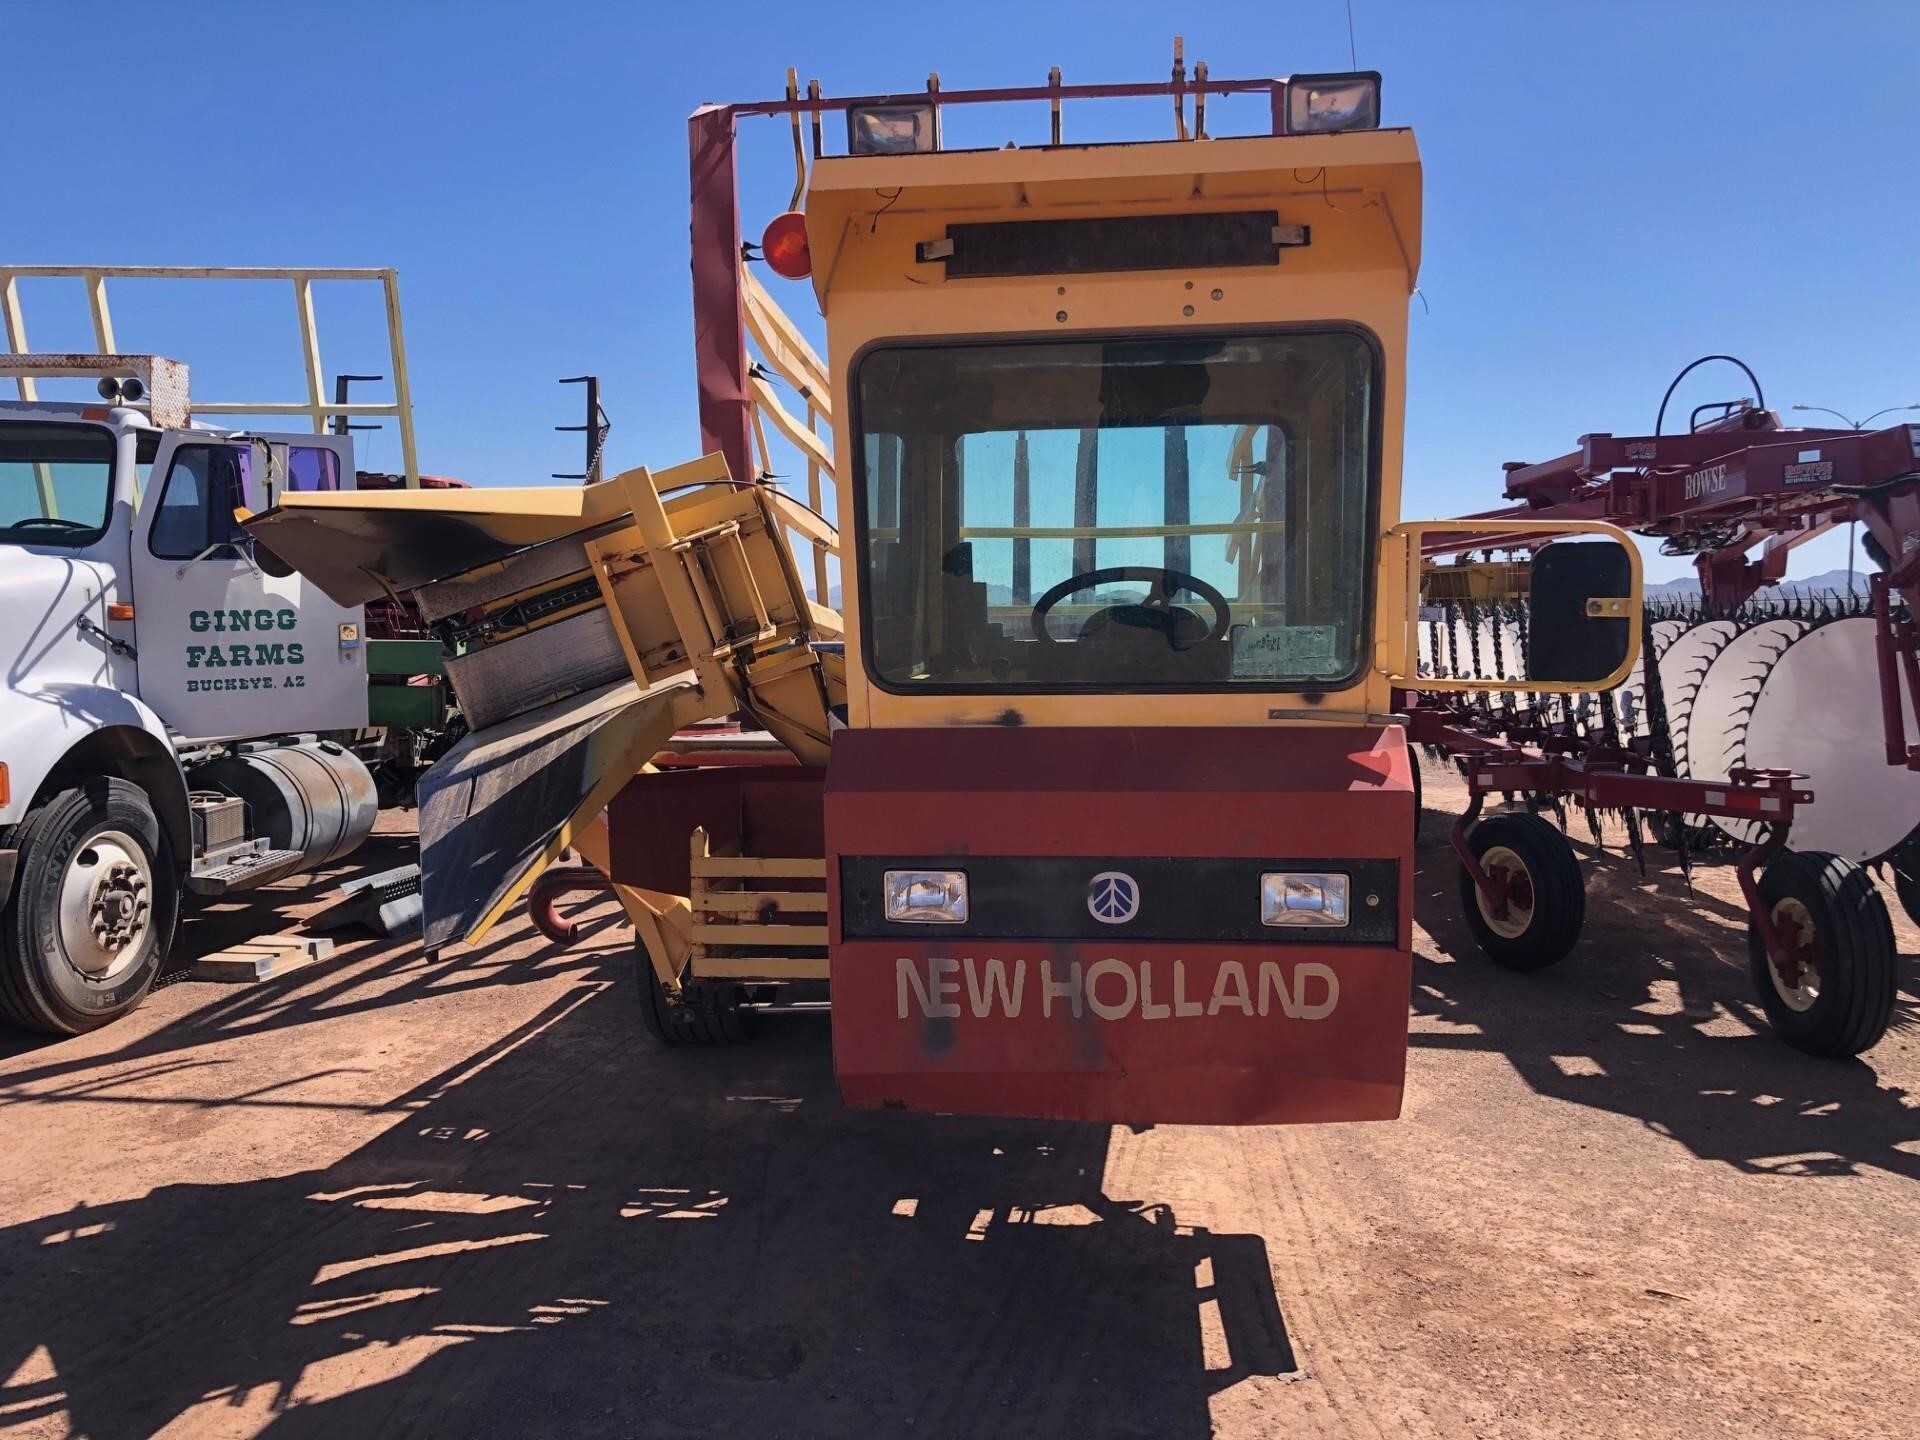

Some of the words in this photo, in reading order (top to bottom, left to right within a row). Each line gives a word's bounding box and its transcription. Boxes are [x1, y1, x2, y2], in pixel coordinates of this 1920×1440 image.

[1684, 464, 1727, 500] ROWSE
[189, 609, 298, 632] GINGG
[186, 643, 305, 668] FARMS
[283, 675, 305, 688] AZ
[895, 958, 1026, 1019] NEW
[1040, 958, 1340, 1020] HOLLAND
